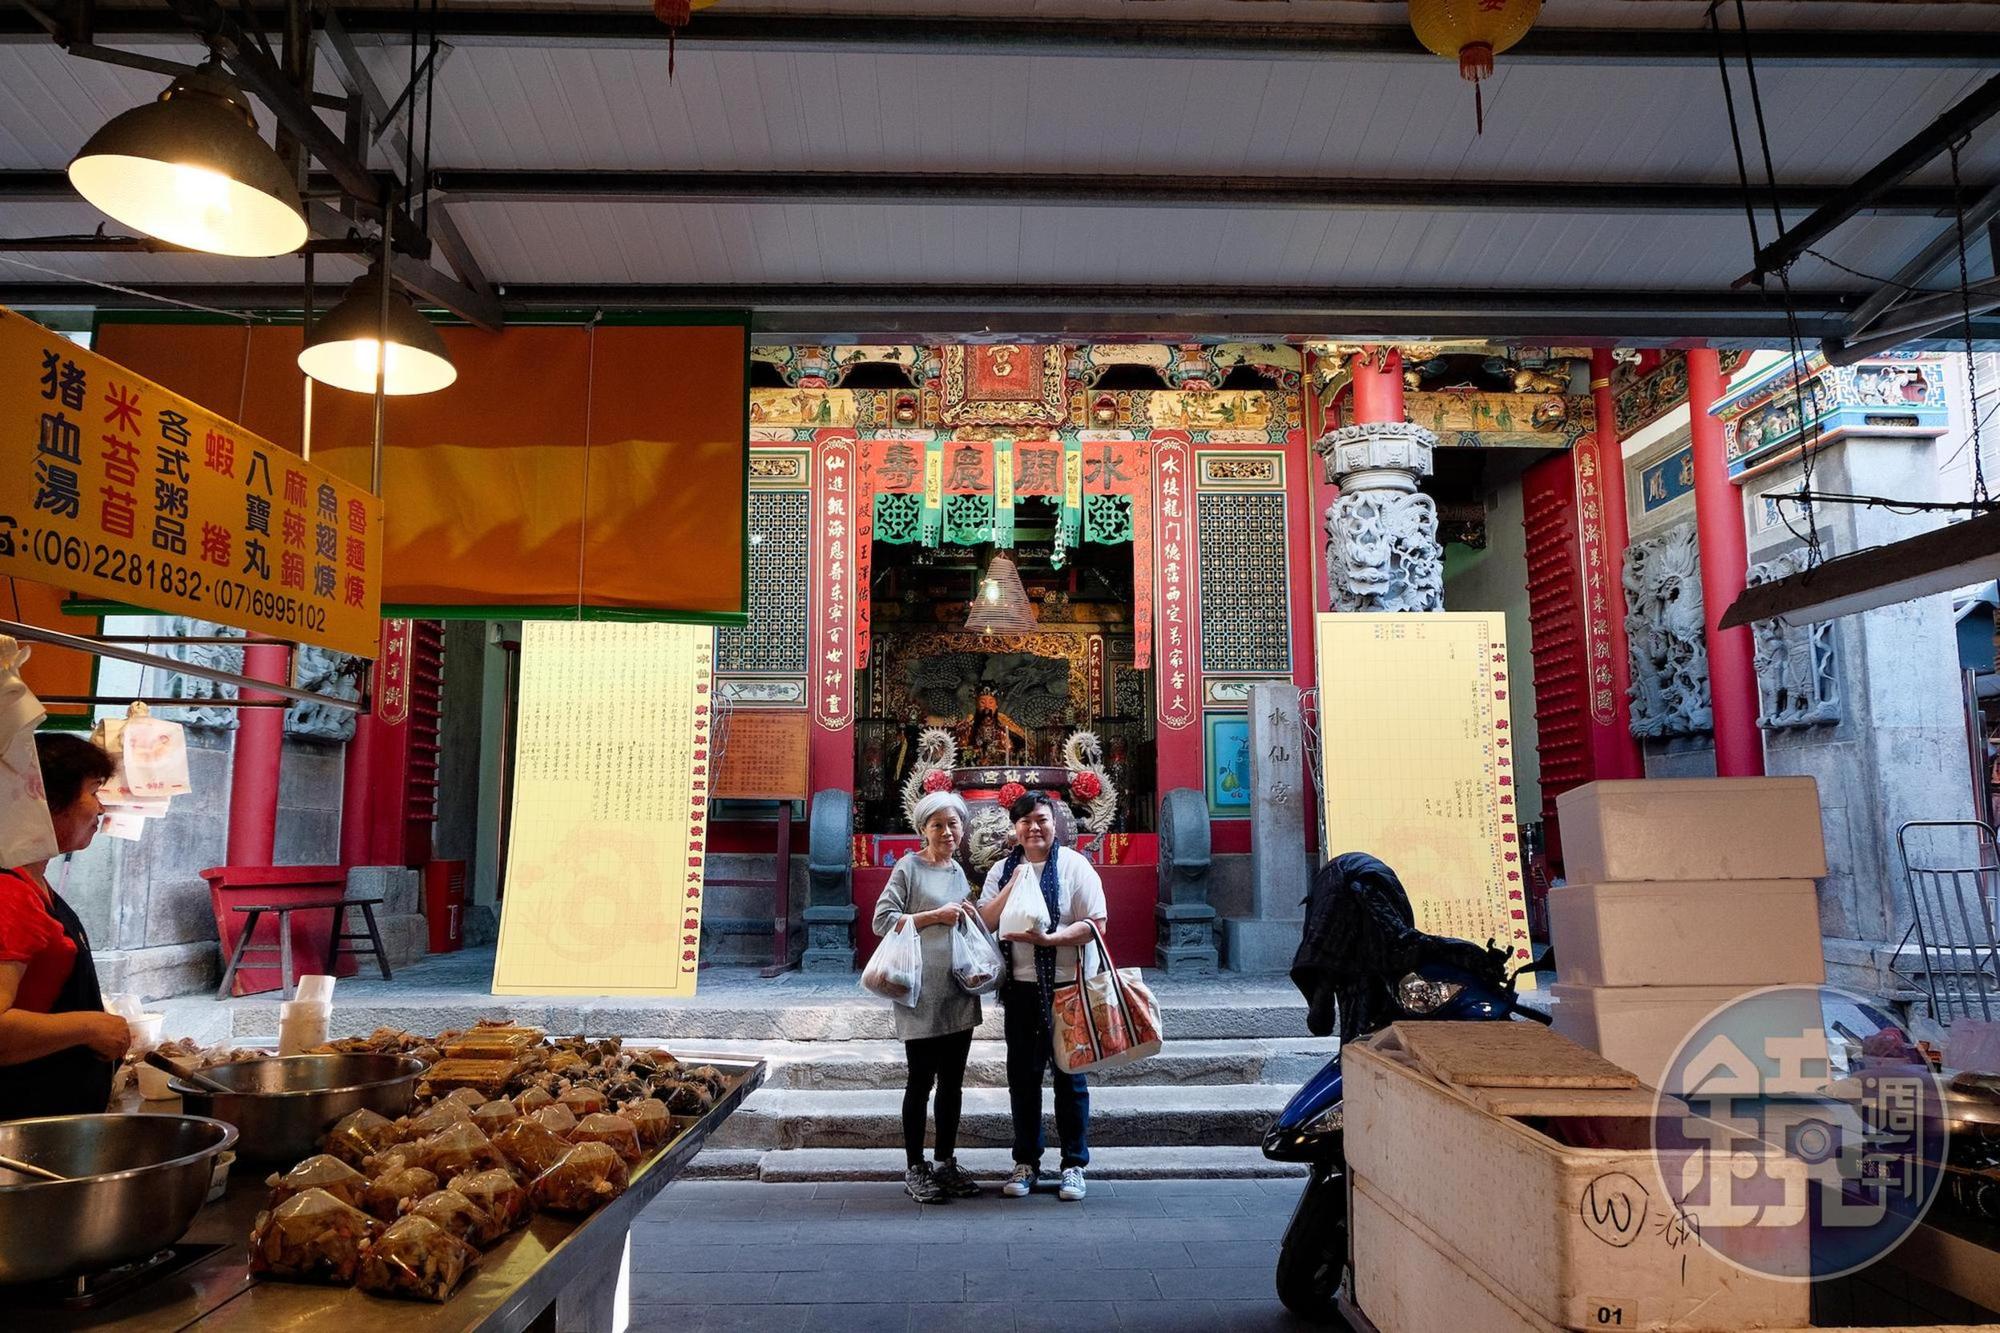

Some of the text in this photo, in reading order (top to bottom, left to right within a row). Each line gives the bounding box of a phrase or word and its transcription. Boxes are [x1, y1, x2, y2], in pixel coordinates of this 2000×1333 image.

[152, 409, 192, 555] 各式粥品
[243, 450, 274, 581] 八寶丸
[279, 468, 309, 592] 麻辣鍋
[695, 653, 711, 694] 水仙宮
[1492, 652, 1507, 701] 水仙宮
[1597, 1306, 1623, 1325] 01
